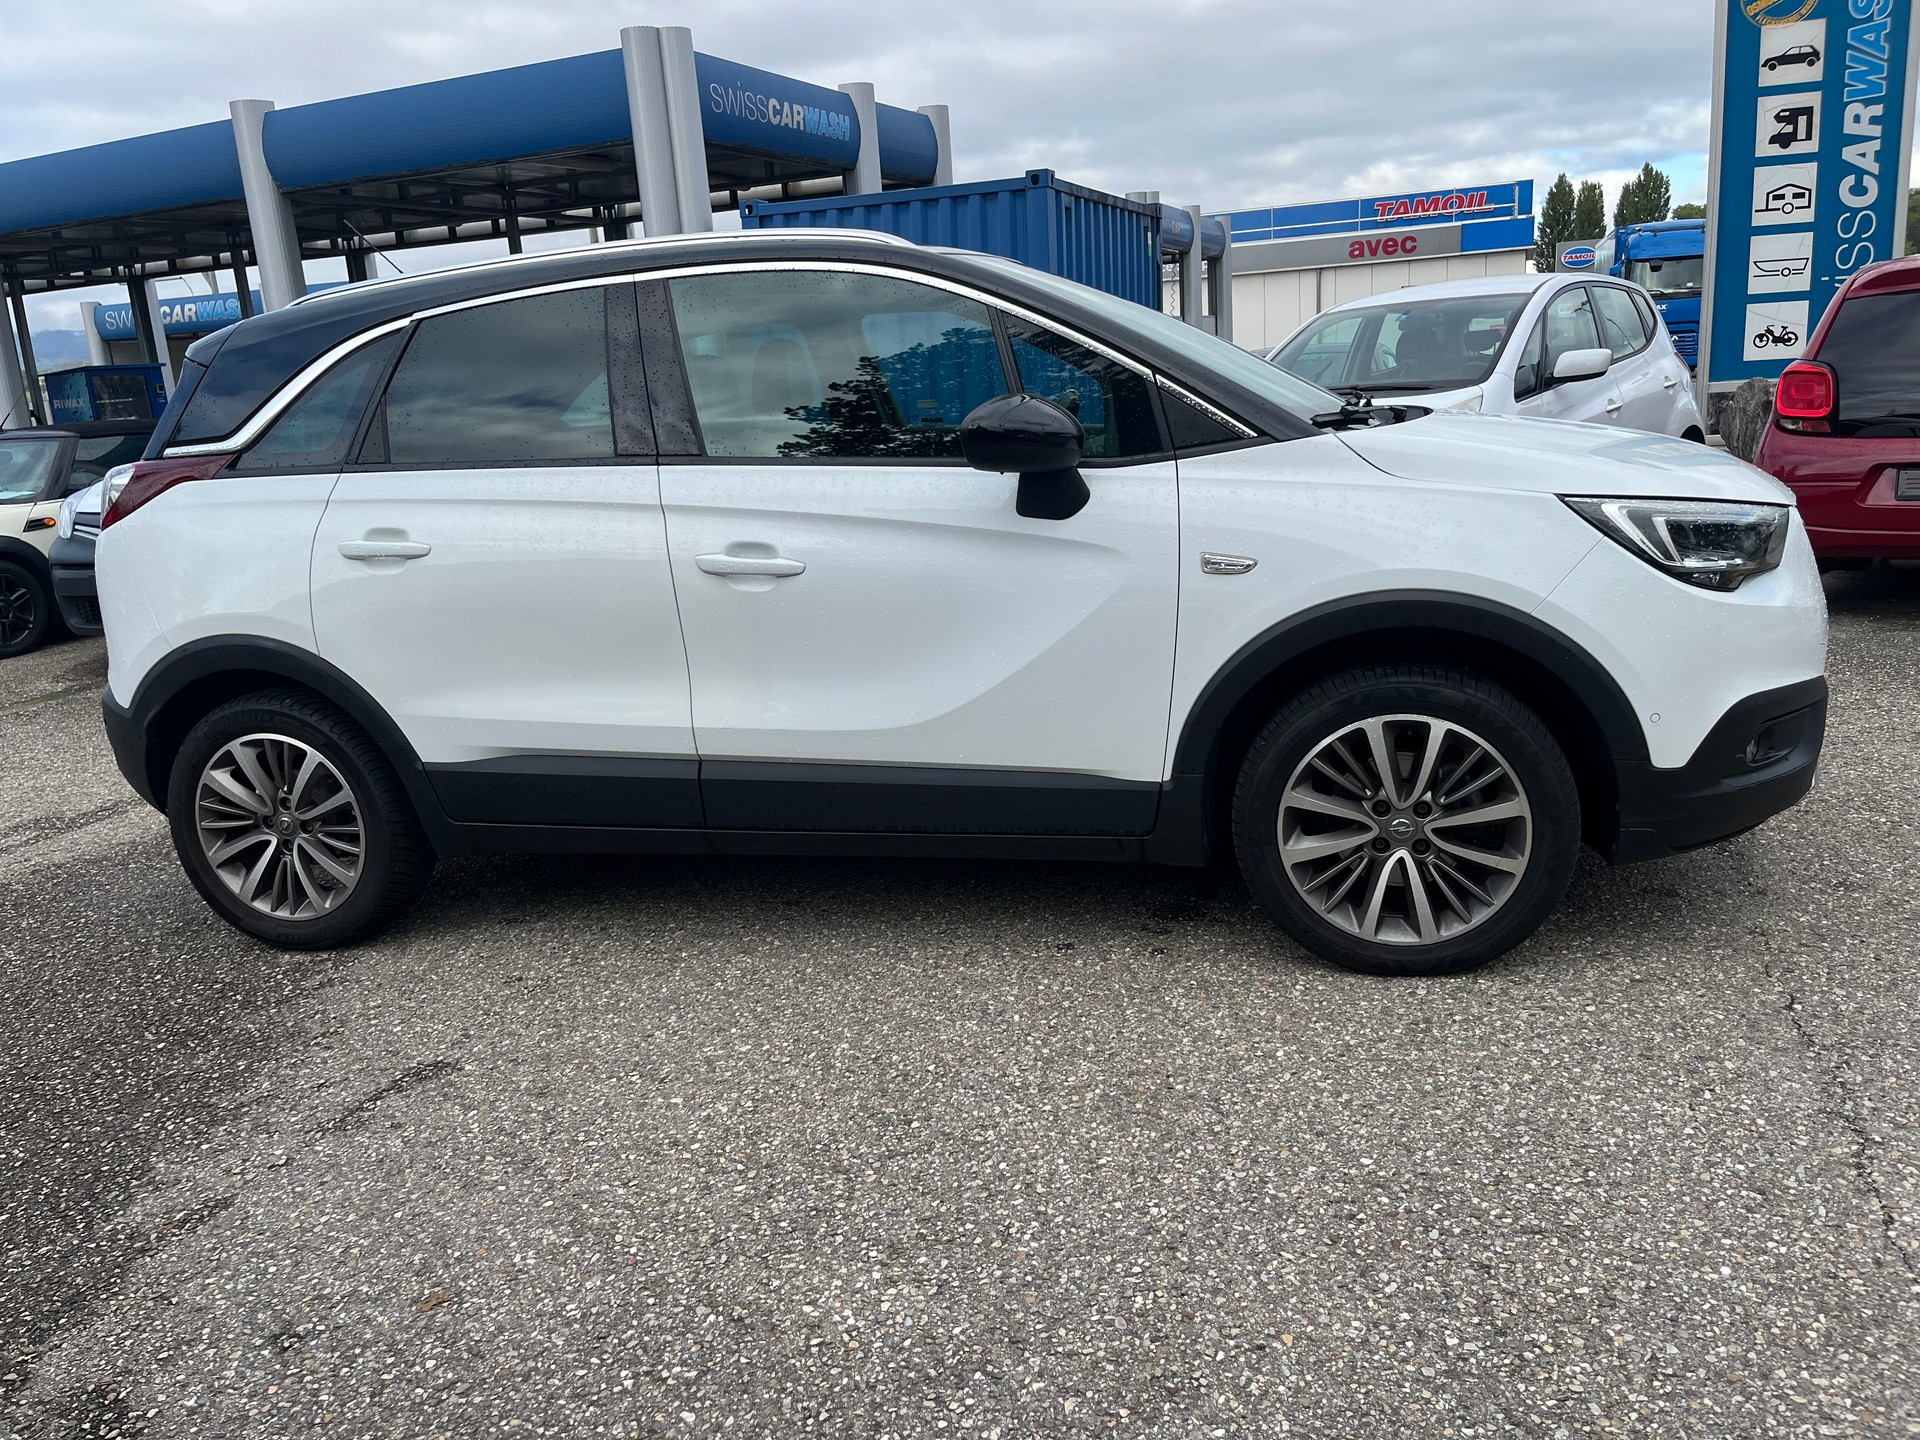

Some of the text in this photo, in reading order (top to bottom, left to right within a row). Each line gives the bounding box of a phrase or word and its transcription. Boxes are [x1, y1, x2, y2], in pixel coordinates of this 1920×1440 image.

[709, 80, 850, 142] SWiSSCARWASH
[1374, 190, 1495, 222] TAMOIL
[1348, 235, 1418, 260] avec
[53, 397, 85, 410] RIWAX
